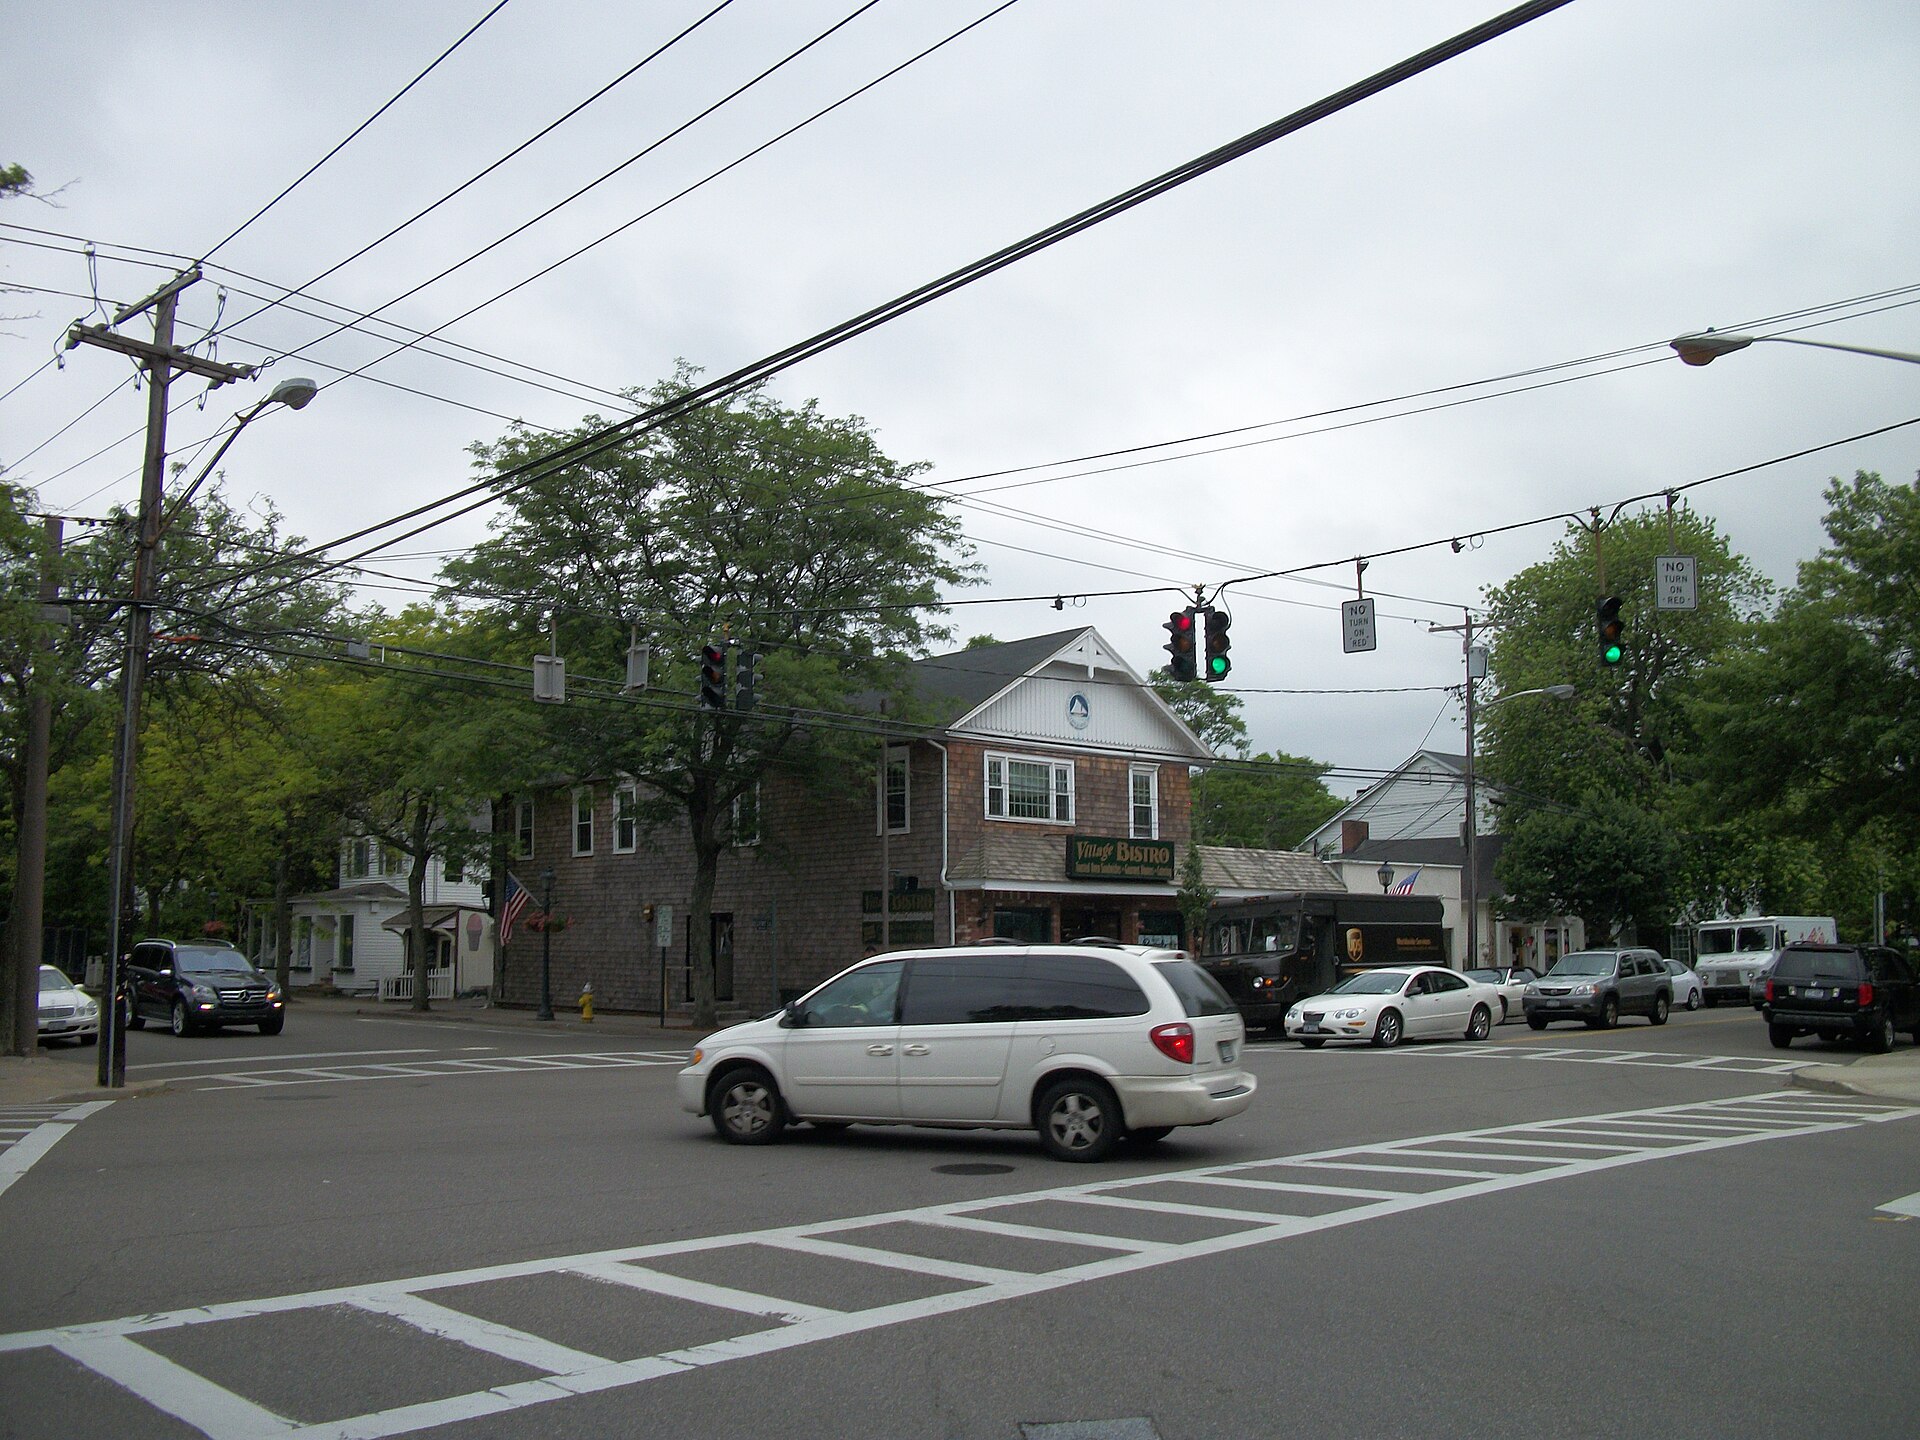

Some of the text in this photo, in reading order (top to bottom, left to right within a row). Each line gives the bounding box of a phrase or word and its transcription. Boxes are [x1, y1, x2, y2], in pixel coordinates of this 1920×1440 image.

[1666, 562, 1684, 571] NO
[1665, 575, 1687, 583] TURN
[1667, 596, 1685, 604] RED
[1350, 605, 1366, 616] NO
[1349, 617, 1369, 627] TURN
[1353, 628, 1364, 637] ON
[1352, 638, 1367, 648] RED
[1076, 841, 1170, 864] Village BISTRO
